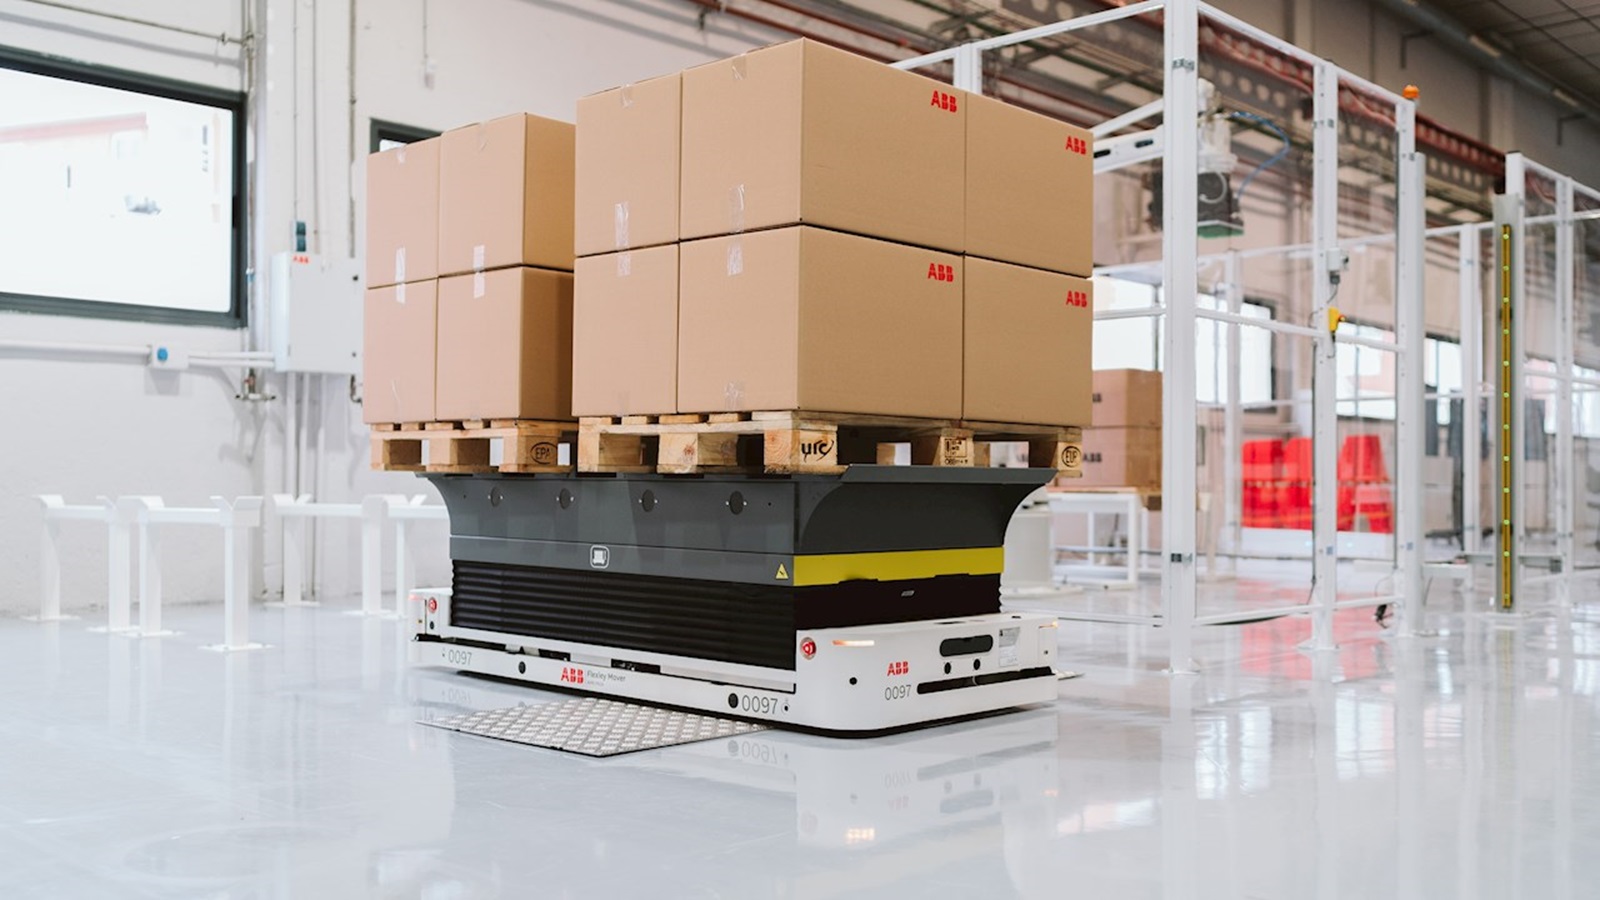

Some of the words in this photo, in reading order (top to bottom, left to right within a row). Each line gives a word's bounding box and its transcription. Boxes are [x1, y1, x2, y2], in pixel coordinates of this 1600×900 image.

[931, 90, 958, 113] ABB
[1065, 136, 1087, 155] ABB
[927, 263, 954, 283] ABB
[1065, 290, 1088, 308] ABB
[448, 649, 473, 665] 0097
[561, 667, 585, 684] ABB
[608, 673, 626, 683] Mover
[887, 661, 909, 677] ABB
[884, 684, 912, 701] 0097
[741, 695, 779, 715] 0097
